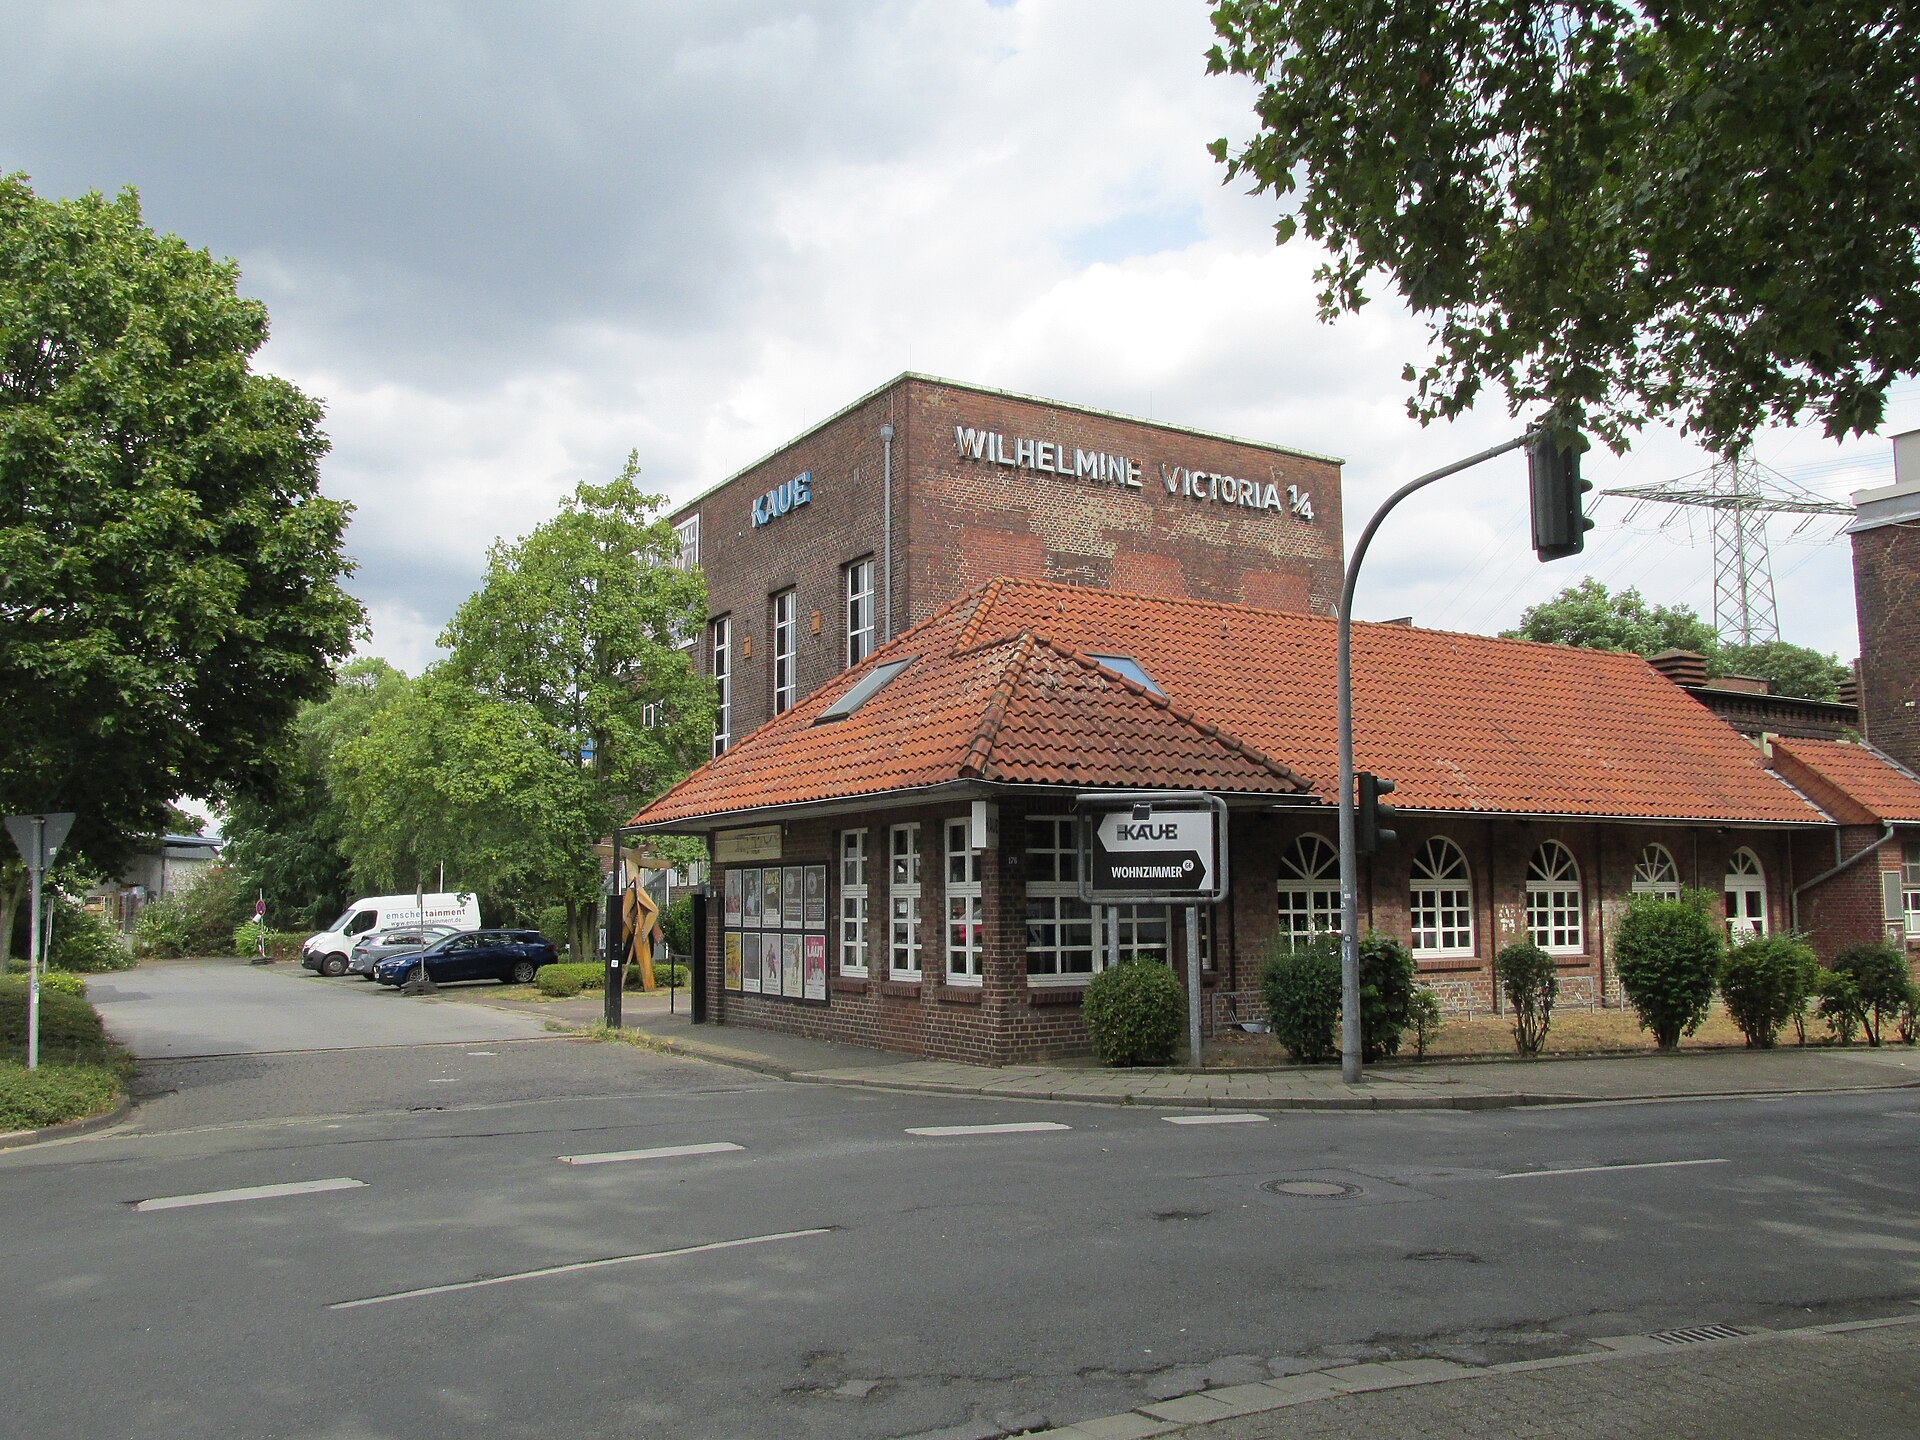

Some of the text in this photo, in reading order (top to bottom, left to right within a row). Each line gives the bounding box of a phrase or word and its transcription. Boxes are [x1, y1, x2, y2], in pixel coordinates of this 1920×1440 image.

[954, 426, 1142, 488] WILHELMINE
[1159, 463, 1282, 512] VICTORIA
[751, 471, 811, 528] KAUE
[1118, 824, 1178, 840] KAUE
[1111, 866, 1183, 879] WOHNZIMMER
[391, 918, 461, 926] www.emscertainment.de
